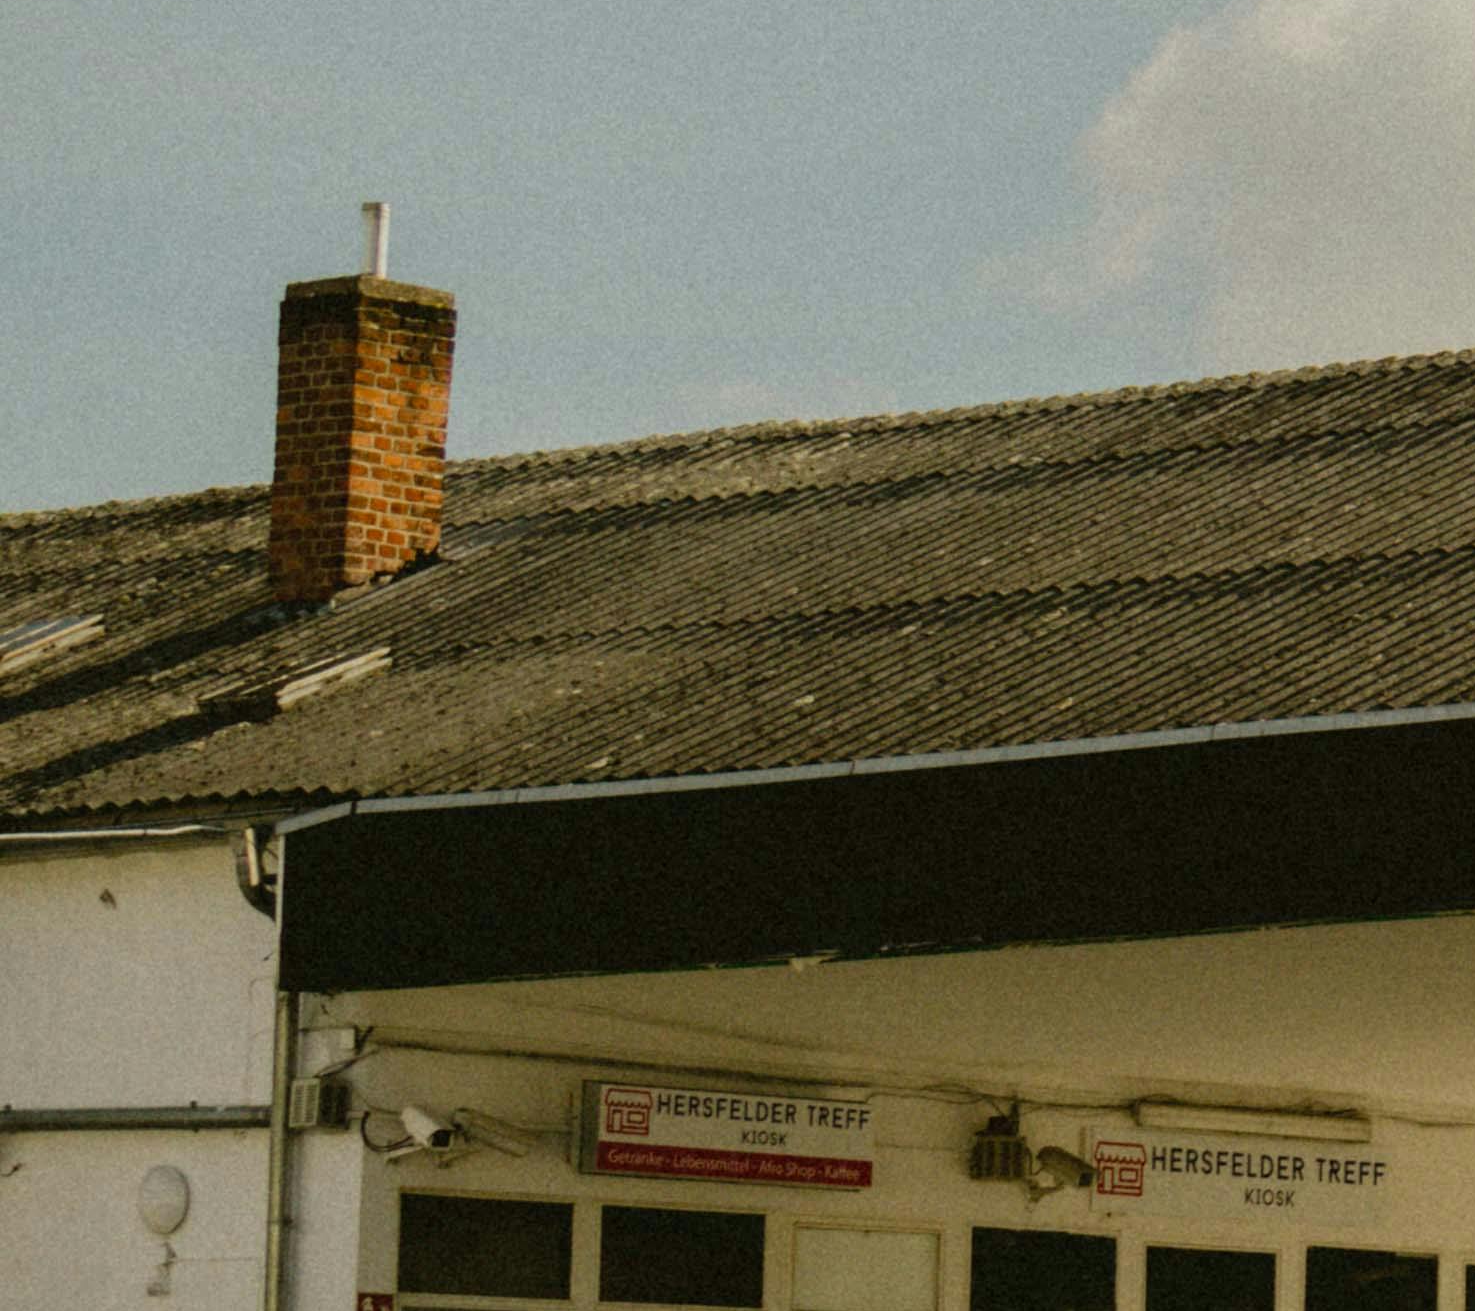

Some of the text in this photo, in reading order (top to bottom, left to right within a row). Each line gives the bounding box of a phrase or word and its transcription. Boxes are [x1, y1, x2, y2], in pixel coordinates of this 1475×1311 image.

[656, 1093, 870, 1129] HERSFELDER TREFF
[741, 1131, 787, 1146] KIOSK
[1151, 1146, 1387, 1186] HERSFELDER TREFF
[1244, 1189, 1295, 1207] KIOSK
